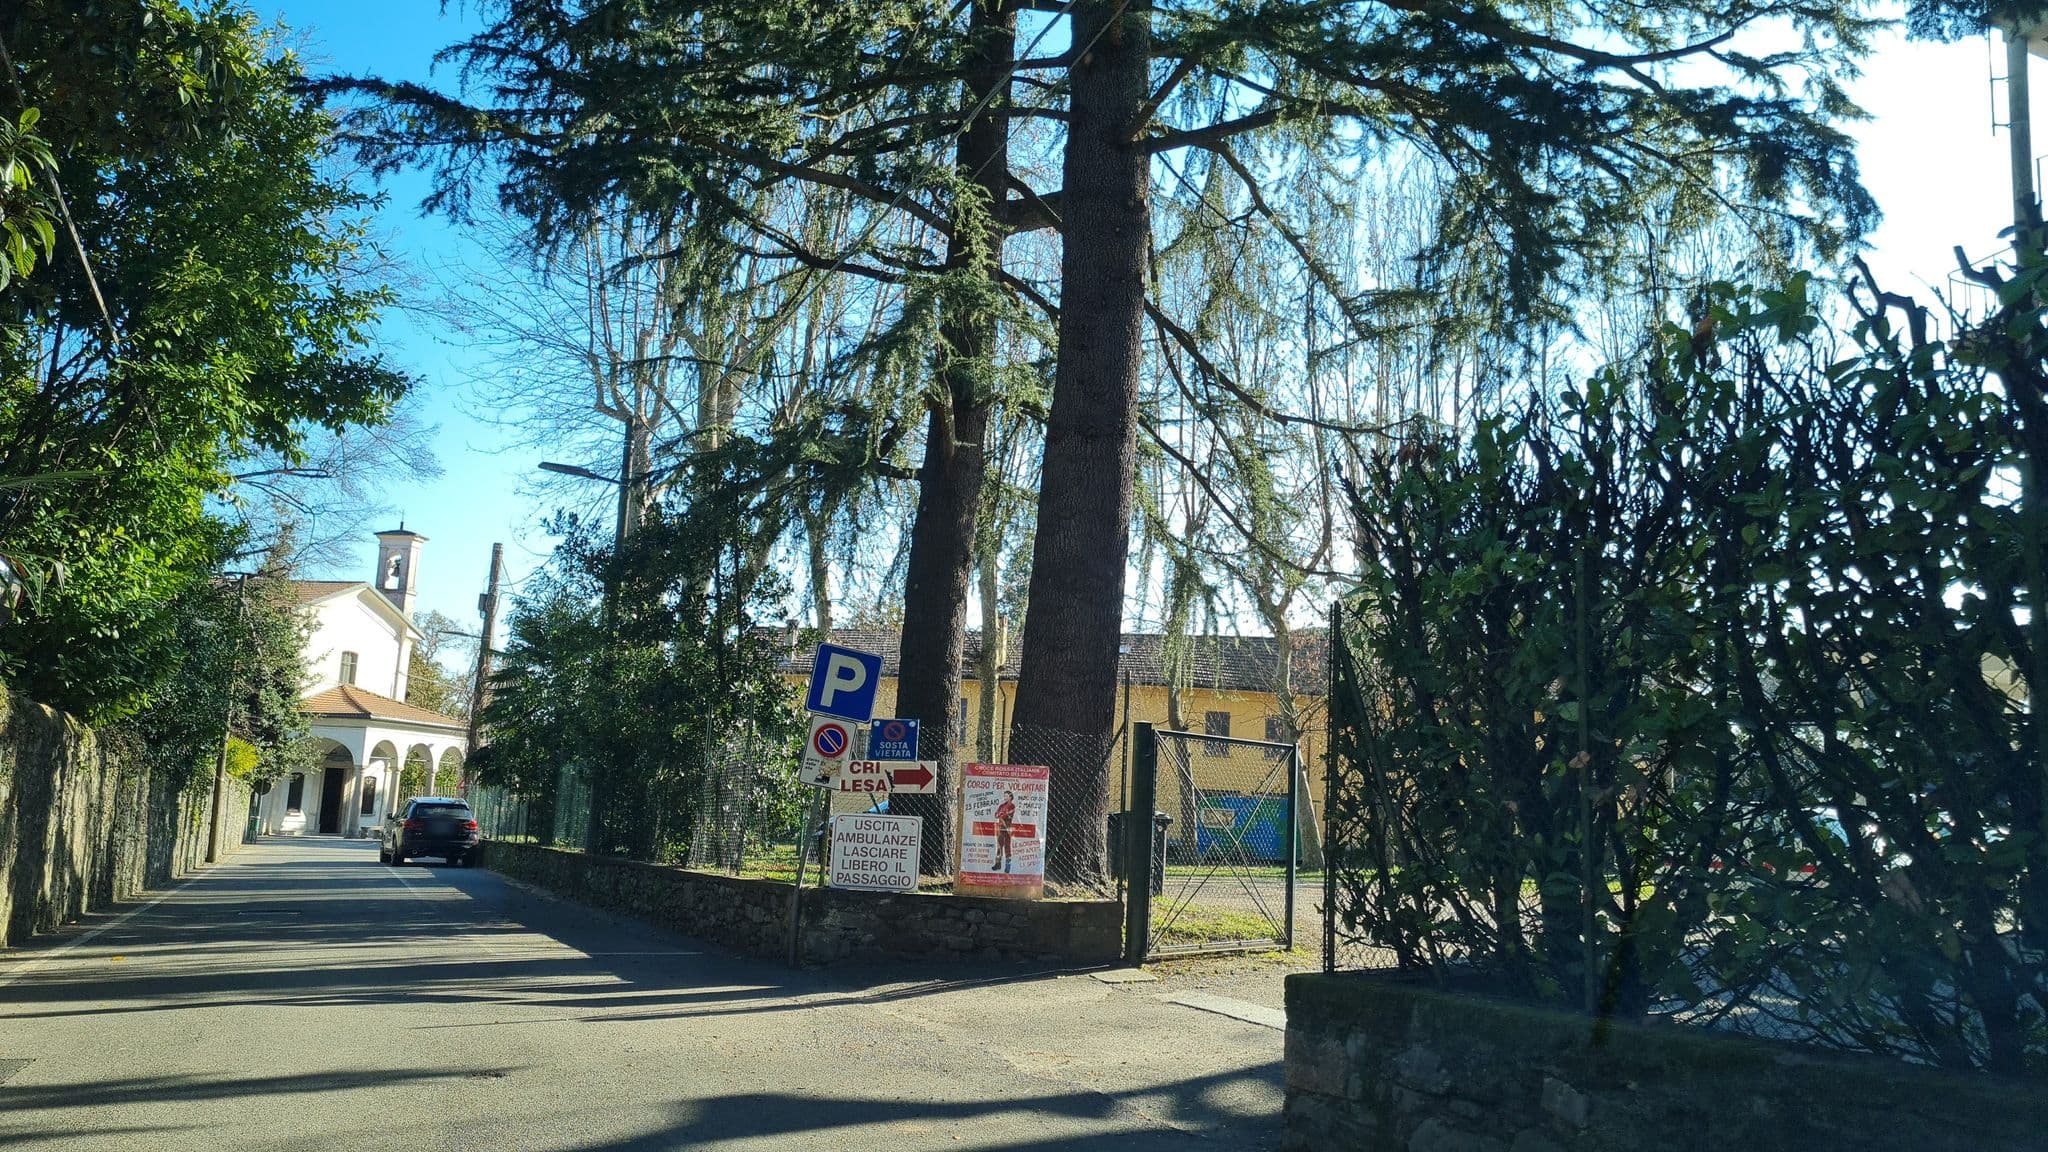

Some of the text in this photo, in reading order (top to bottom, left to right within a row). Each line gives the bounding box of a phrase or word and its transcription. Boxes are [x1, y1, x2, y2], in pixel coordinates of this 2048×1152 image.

[820, 653, 866, 707] P
[879, 741, 908, 750] SOSTA
[875, 750, 911, 758] VIETATA
[849, 761, 881, 774] CRI
[840, 779, 888, 792] LESA
[967, 780, 990, 790] CORSO
[992, 781, 1006, 791] PER
[1008, 783, 1047, 793] VOLONTARI
[854, 819, 900, 832] USCITA
[836, 832, 917, 846] AMBULANZE
[843, 846, 908, 860] LASCIARE
[841, 859, 906, 873] LIBERO IL
[836, 873, 911, 887] PASSAGGIO
